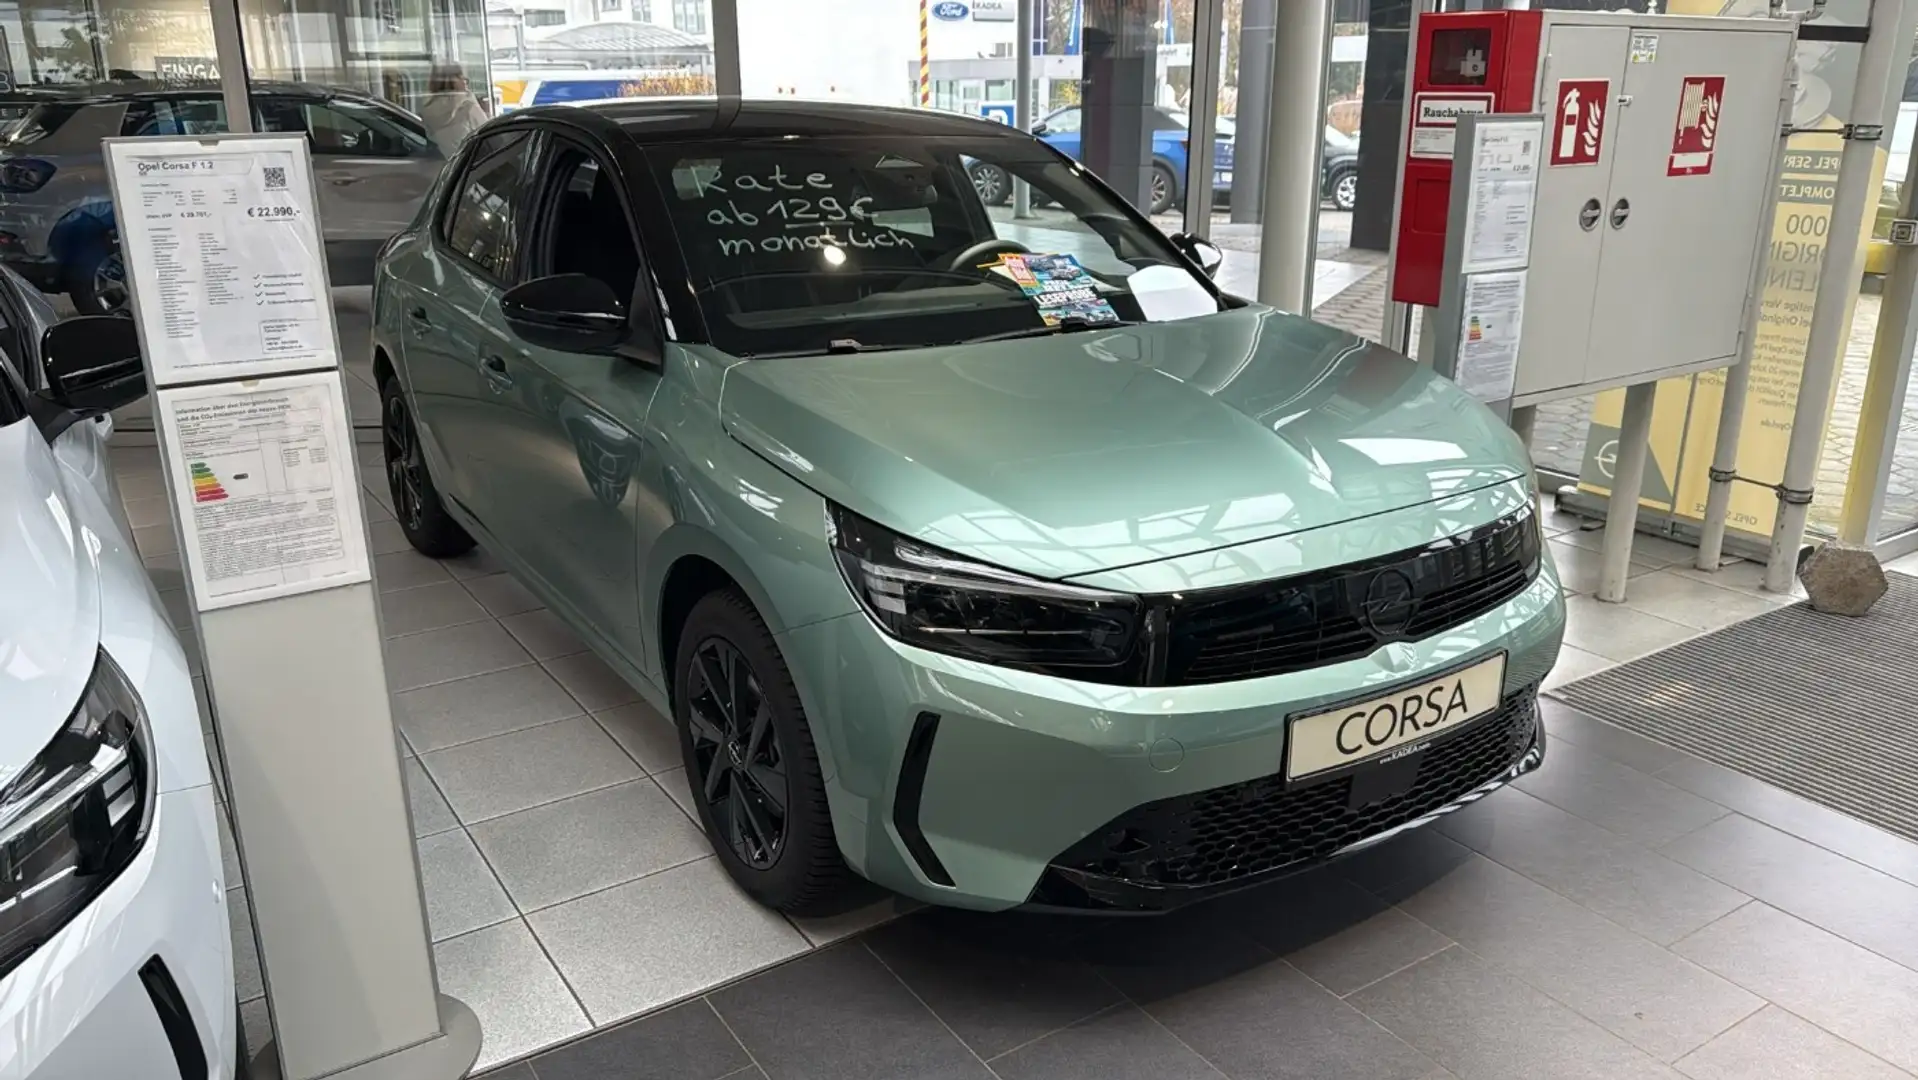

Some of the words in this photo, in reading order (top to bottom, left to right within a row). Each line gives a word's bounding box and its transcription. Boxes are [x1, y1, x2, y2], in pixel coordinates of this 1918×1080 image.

[940, 4, 963, 16] Ford
[1423, 106, 1484, 118] Rauchab
[138, 161, 160, 172] Opel
[162, 161, 190, 171] Corsa
[690, 164, 833, 198] Rate
[247, 207, 255, 217] €
[257, 206, 301, 218] 22.990,-
[707, 200, 759, 226] ab
[718, 228, 916, 256] monatlich
[1336, 678, 1468, 755] CORSA
